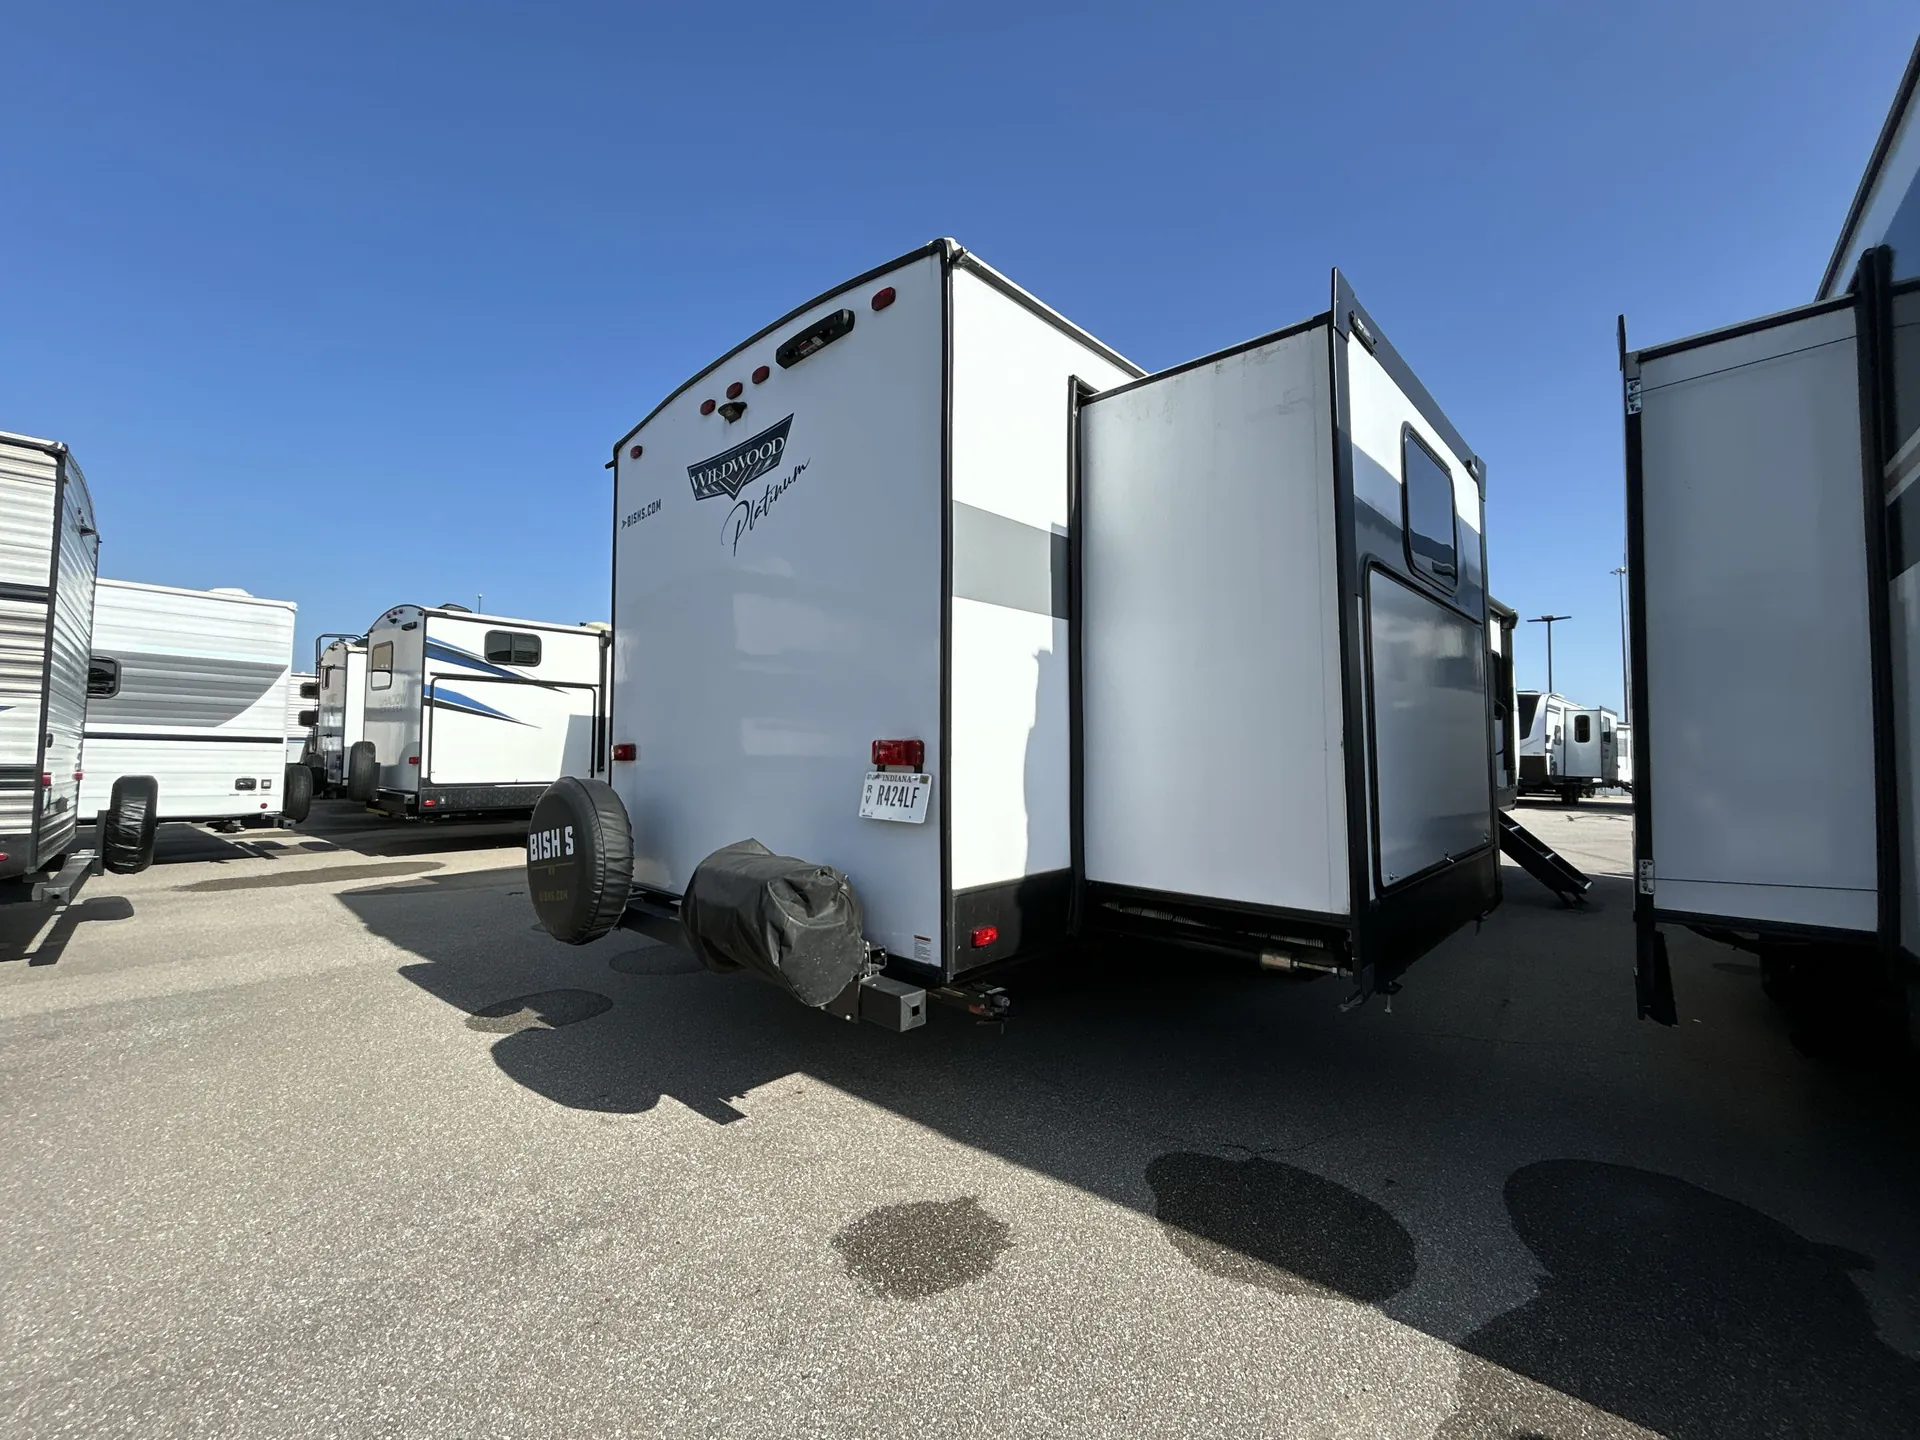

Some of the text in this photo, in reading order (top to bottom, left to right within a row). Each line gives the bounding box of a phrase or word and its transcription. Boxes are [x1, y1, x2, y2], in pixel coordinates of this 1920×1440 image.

[691, 436, 785, 491] WILDWOOD
[721, 457, 812, 557] Platinum
[876, 785, 920, 808] R424LF
[882, 774, 912, 783] INDIANA
